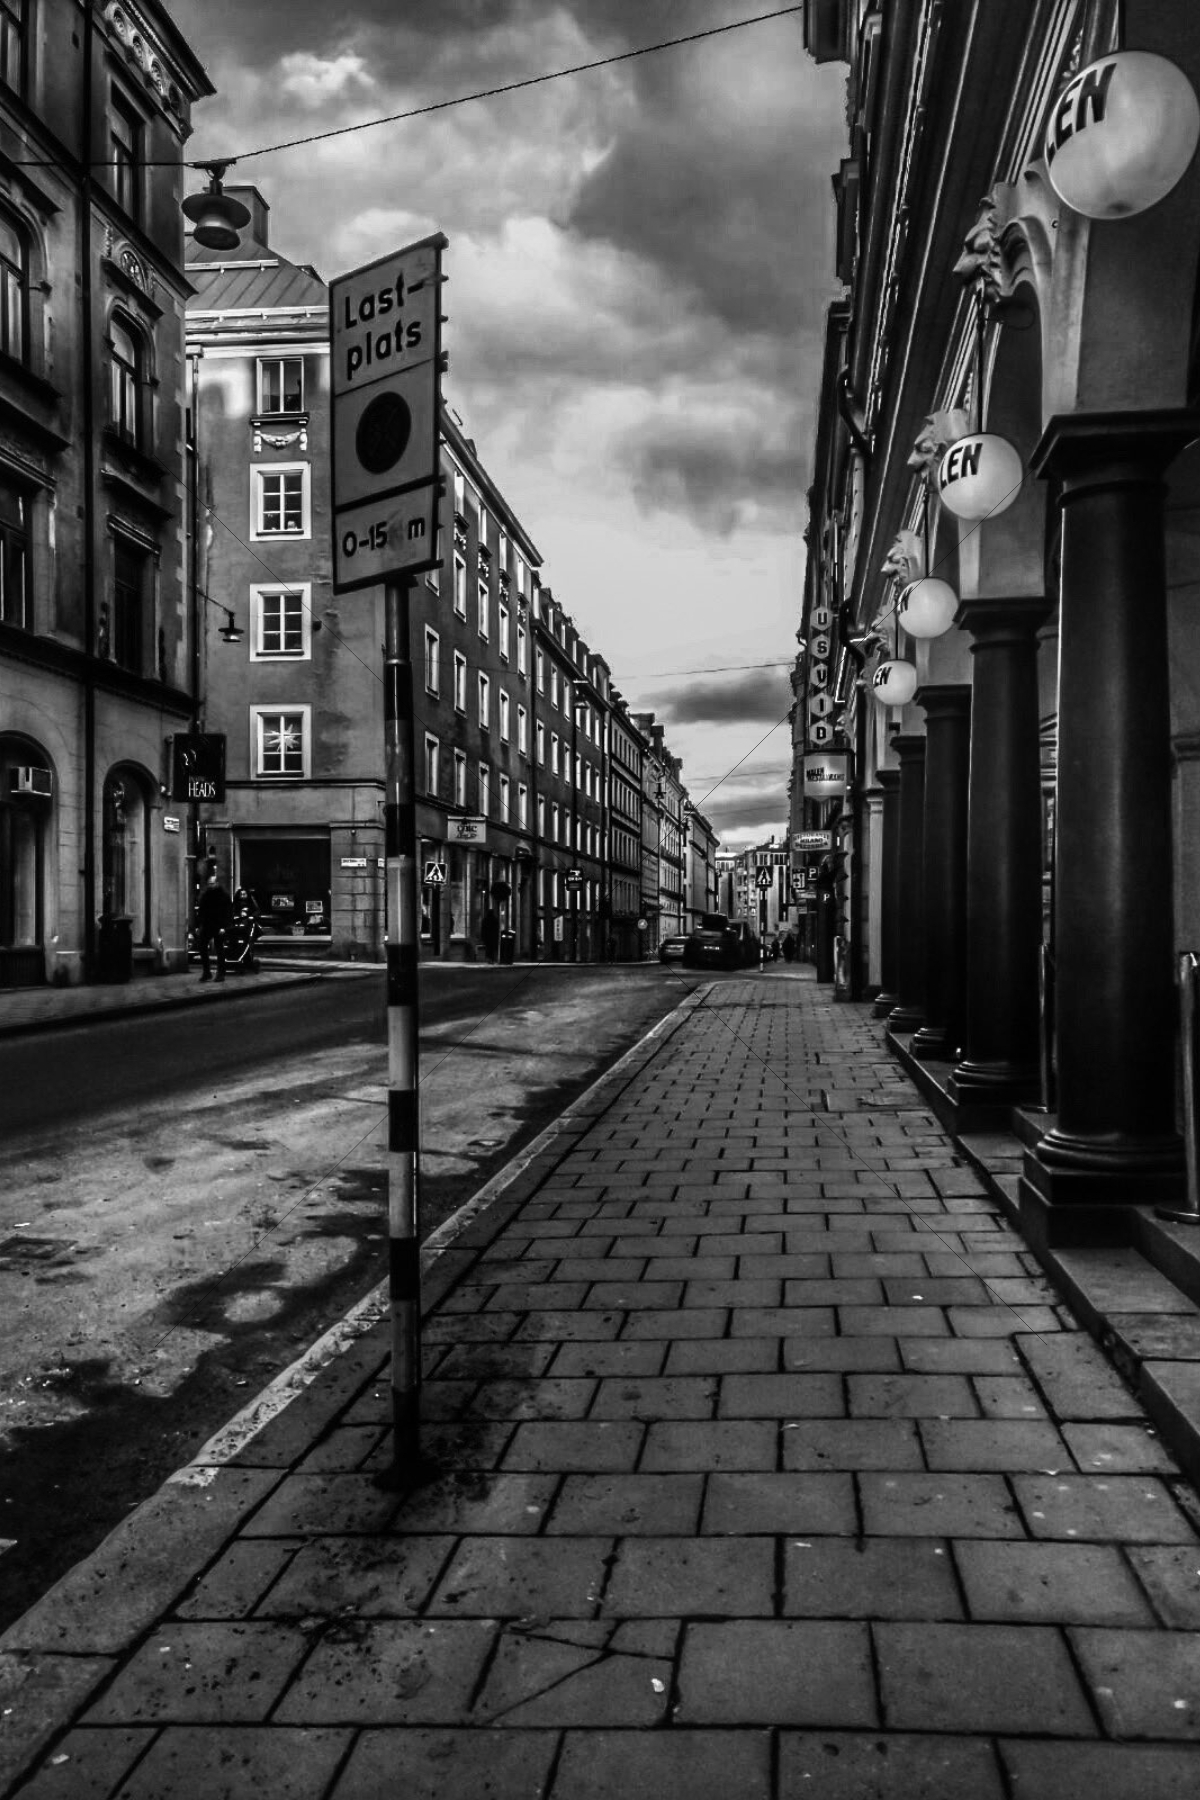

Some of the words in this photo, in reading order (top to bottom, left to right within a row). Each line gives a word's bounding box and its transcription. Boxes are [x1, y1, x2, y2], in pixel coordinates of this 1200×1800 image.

[345, 271, 424, 329] Last-
[346, 319, 422, 381] plats
[343, 521, 388, 558] 0-15
[408, 517, 426, 541] m
[188, 781, 216, 798] HEADS
[809, 867, 817, 878] P
